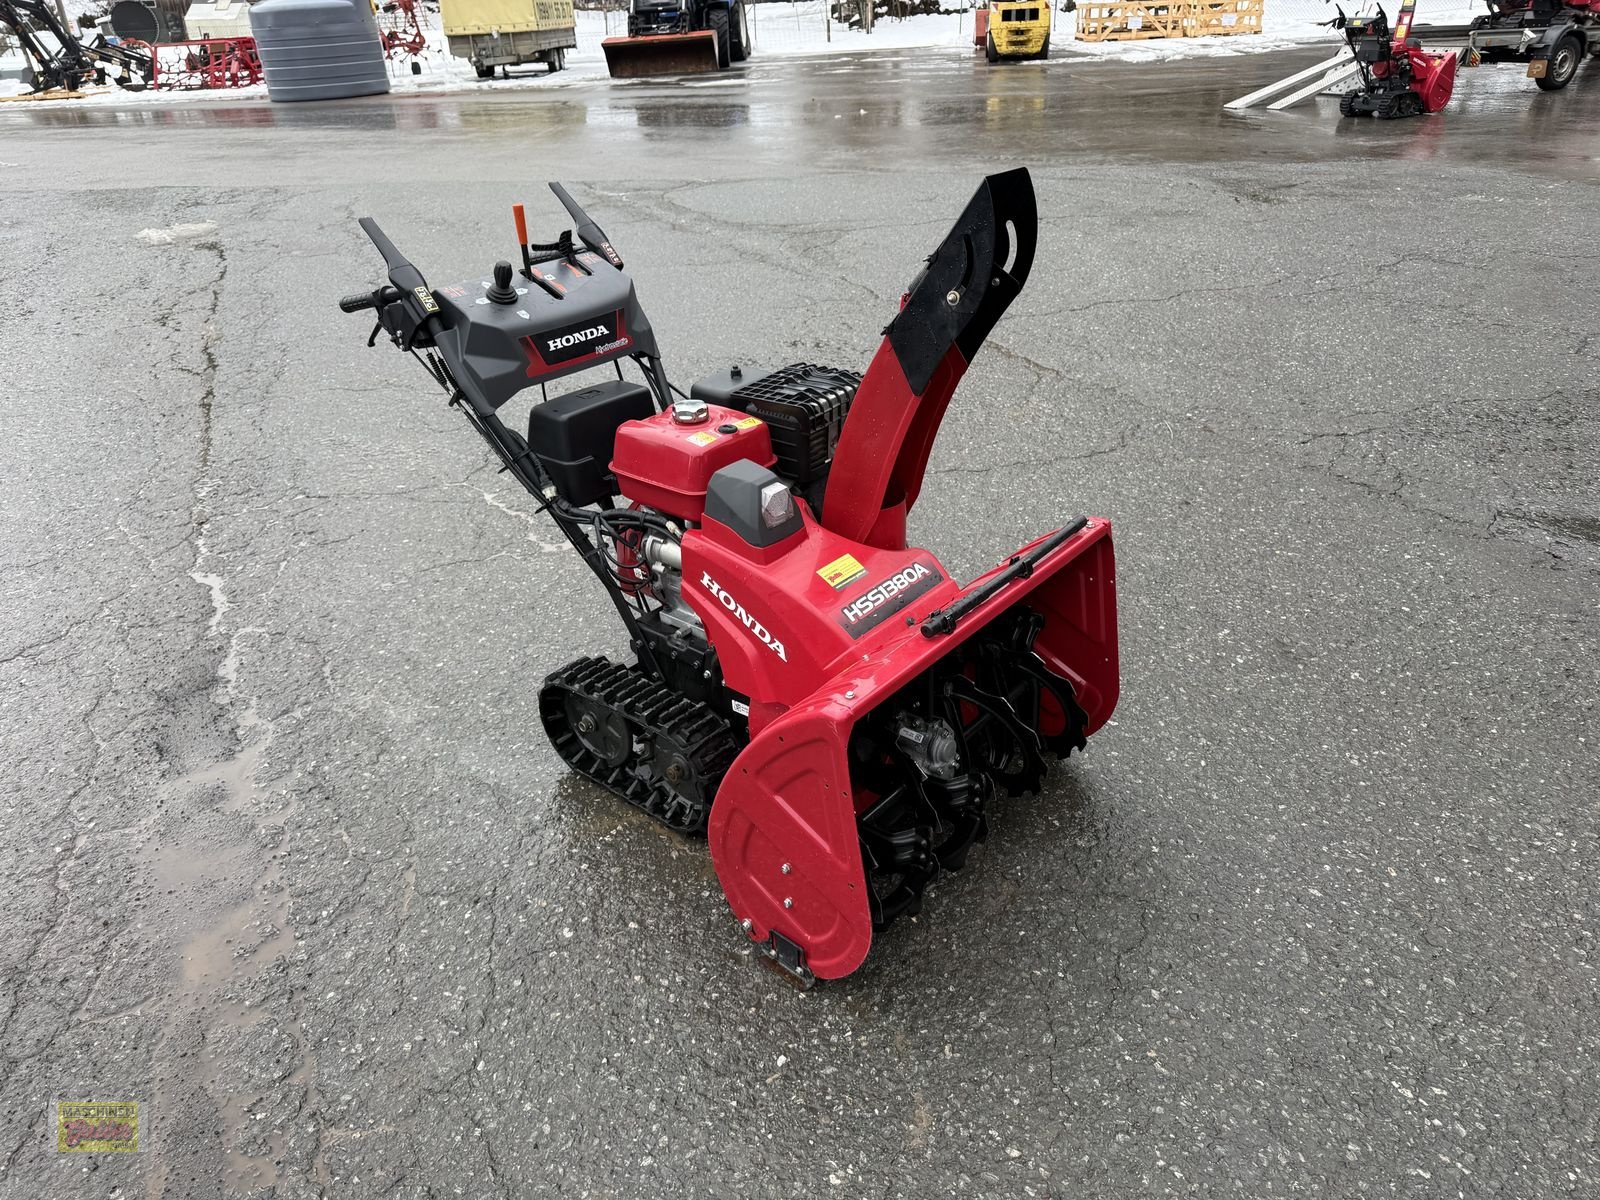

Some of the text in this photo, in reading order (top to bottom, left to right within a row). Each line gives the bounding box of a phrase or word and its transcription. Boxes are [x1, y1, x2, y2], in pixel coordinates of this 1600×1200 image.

[547, 324, 610, 352] HONDA
[700, 570, 788, 663] HONDA
[843, 562, 930, 622] HSS1380A
